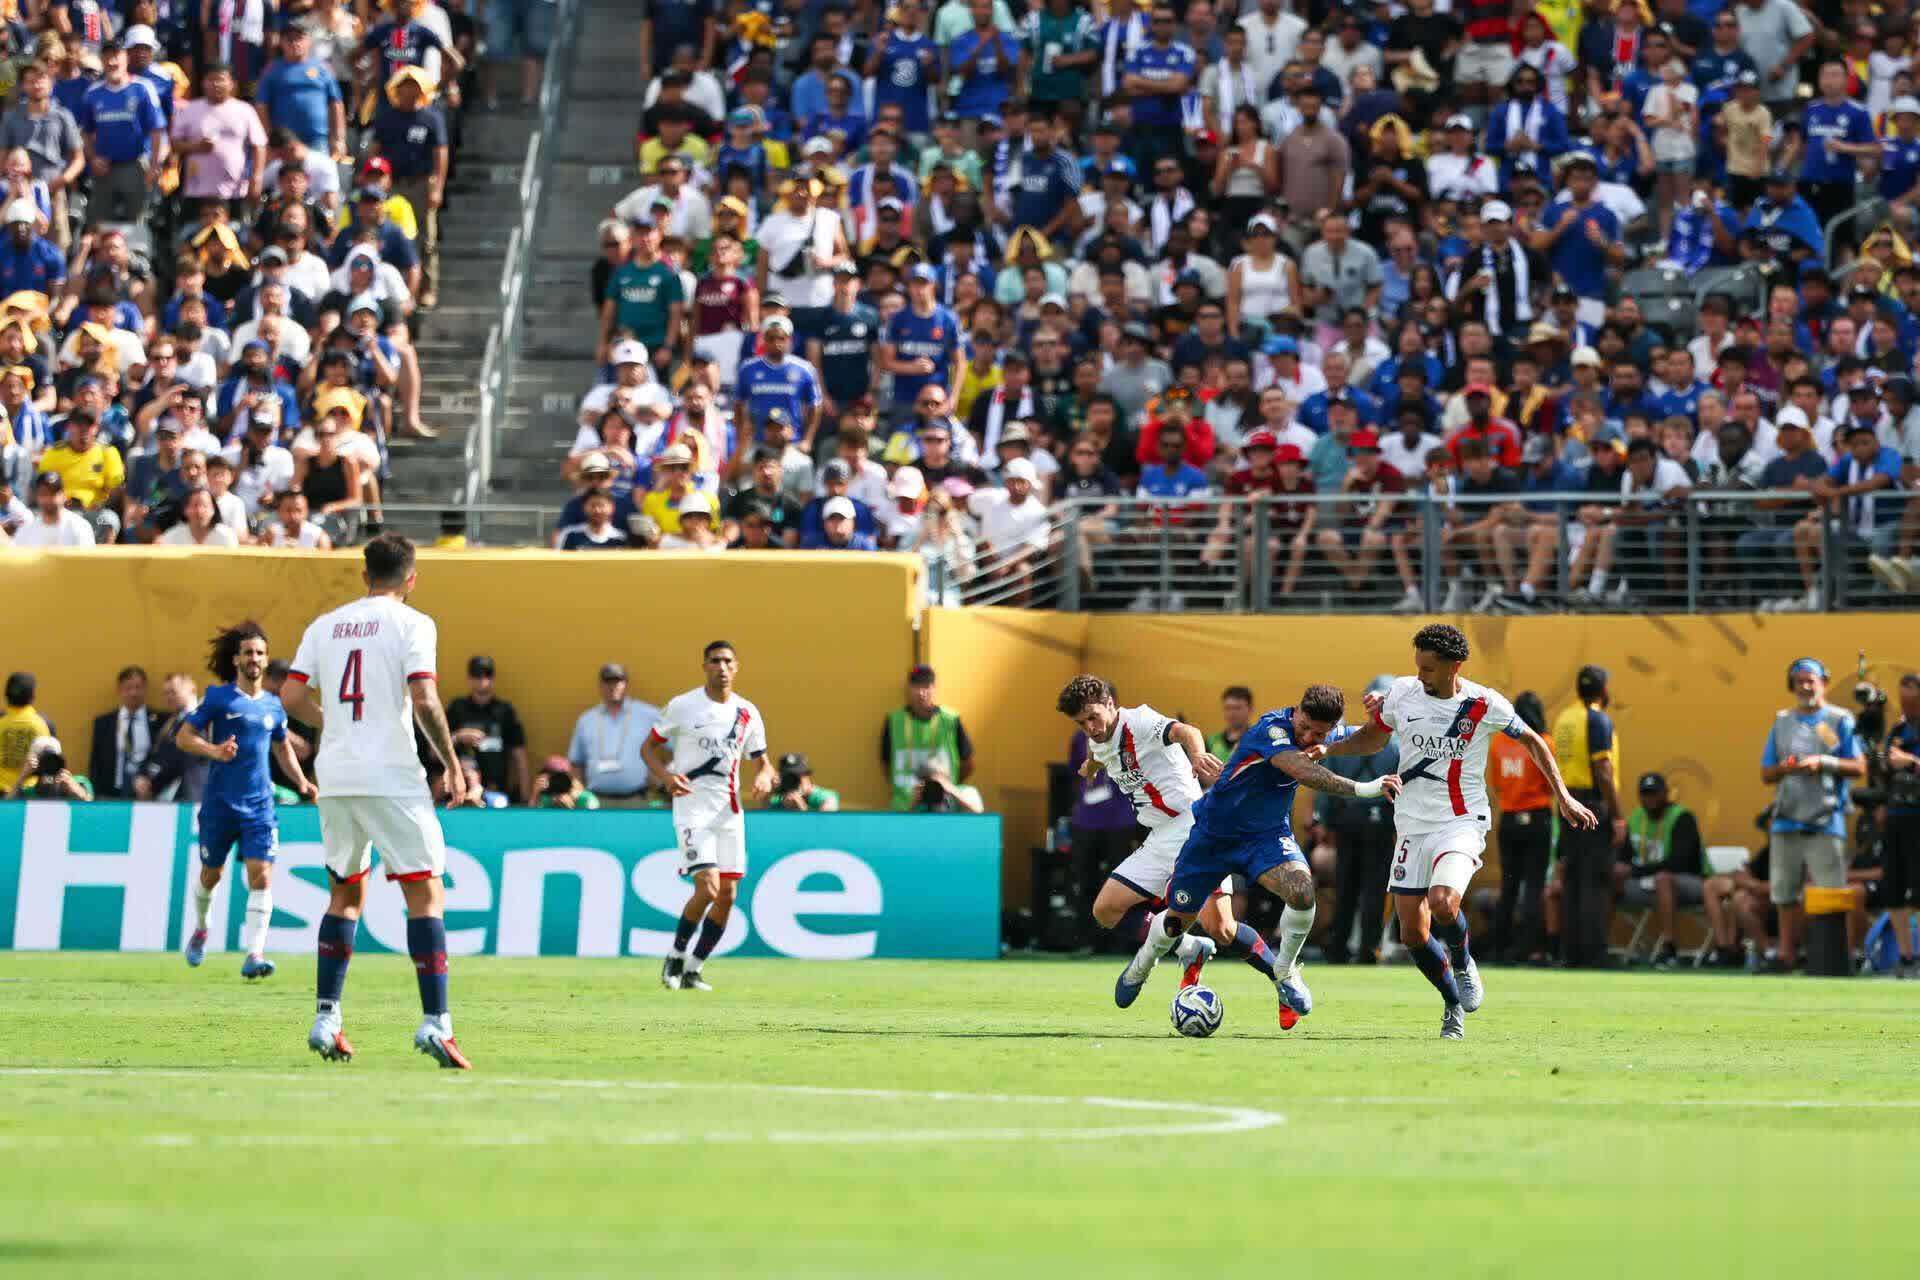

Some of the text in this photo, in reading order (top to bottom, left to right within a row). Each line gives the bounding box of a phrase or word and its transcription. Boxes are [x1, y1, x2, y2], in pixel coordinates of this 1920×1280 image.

[332, 620, 380, 639] BERALDO
[339, 649, 364, 721] 4
[1411, 734, 1466, 751] QATAR
[1424, 748, 1464, 759] AIRWAYS
[683, 828, 693, 848] 2
[1397, 839, 1410, 864] 5
[13, 800, 884, 958] Hisense
